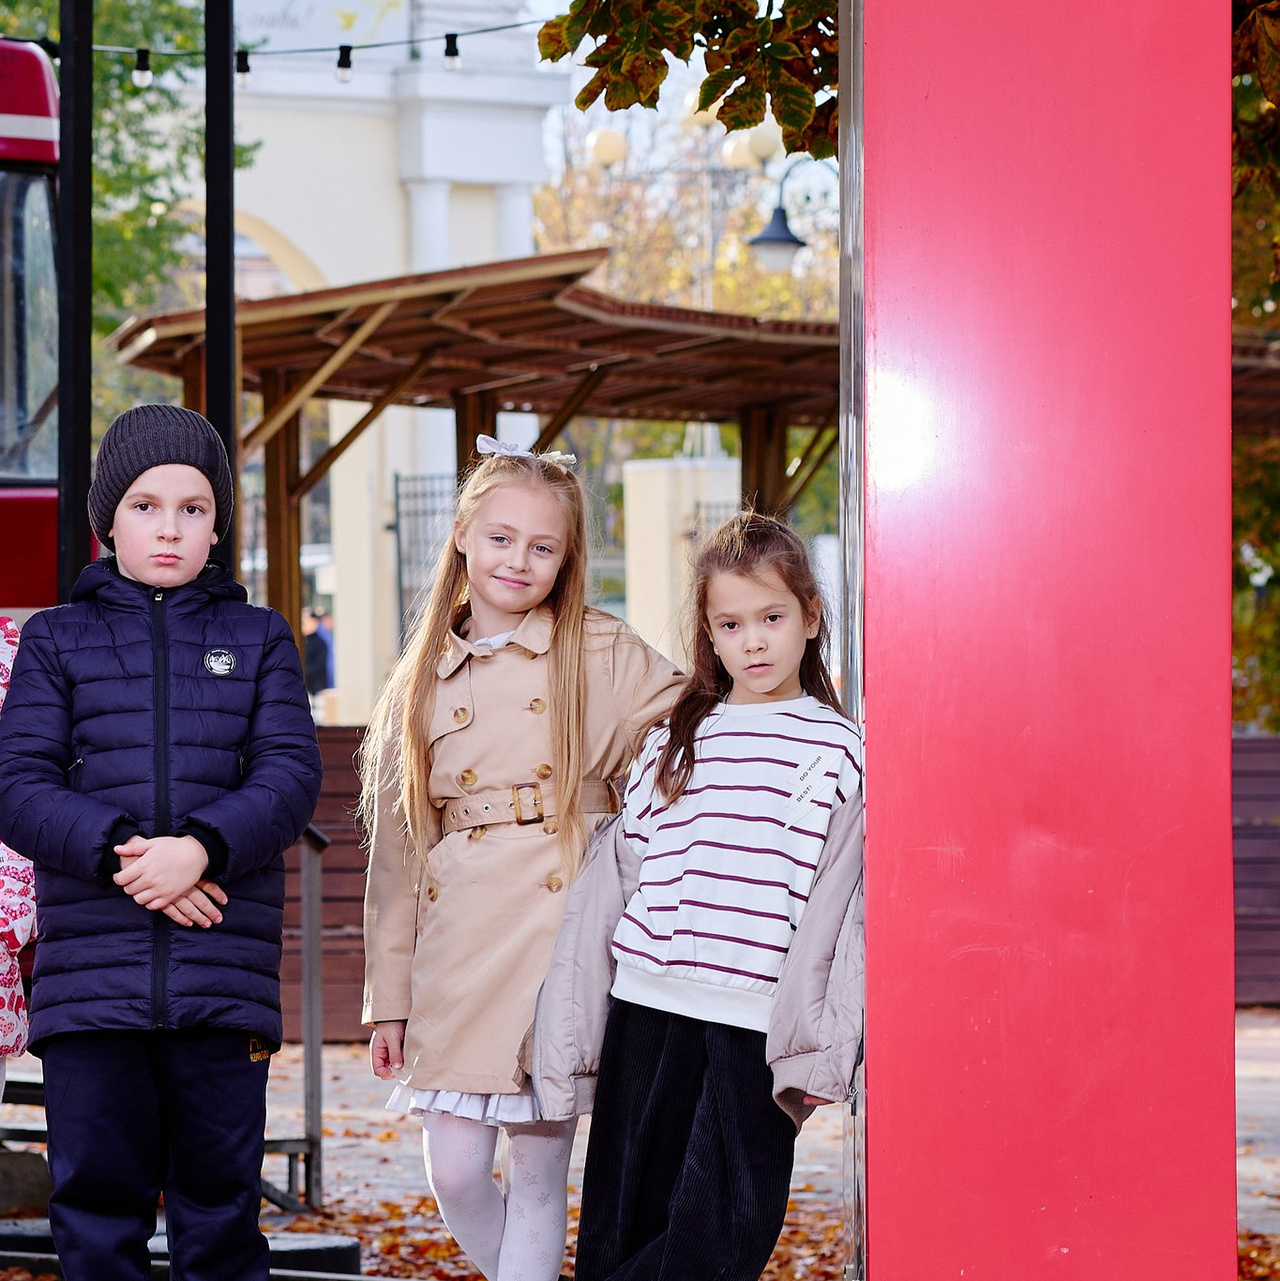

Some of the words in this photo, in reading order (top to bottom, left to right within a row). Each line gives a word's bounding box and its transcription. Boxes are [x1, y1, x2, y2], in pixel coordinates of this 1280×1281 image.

[799, 771, 809, 782] DO
[807, 755, 823, 772] YOUR
[796, 784, 813, 803] BEST!
